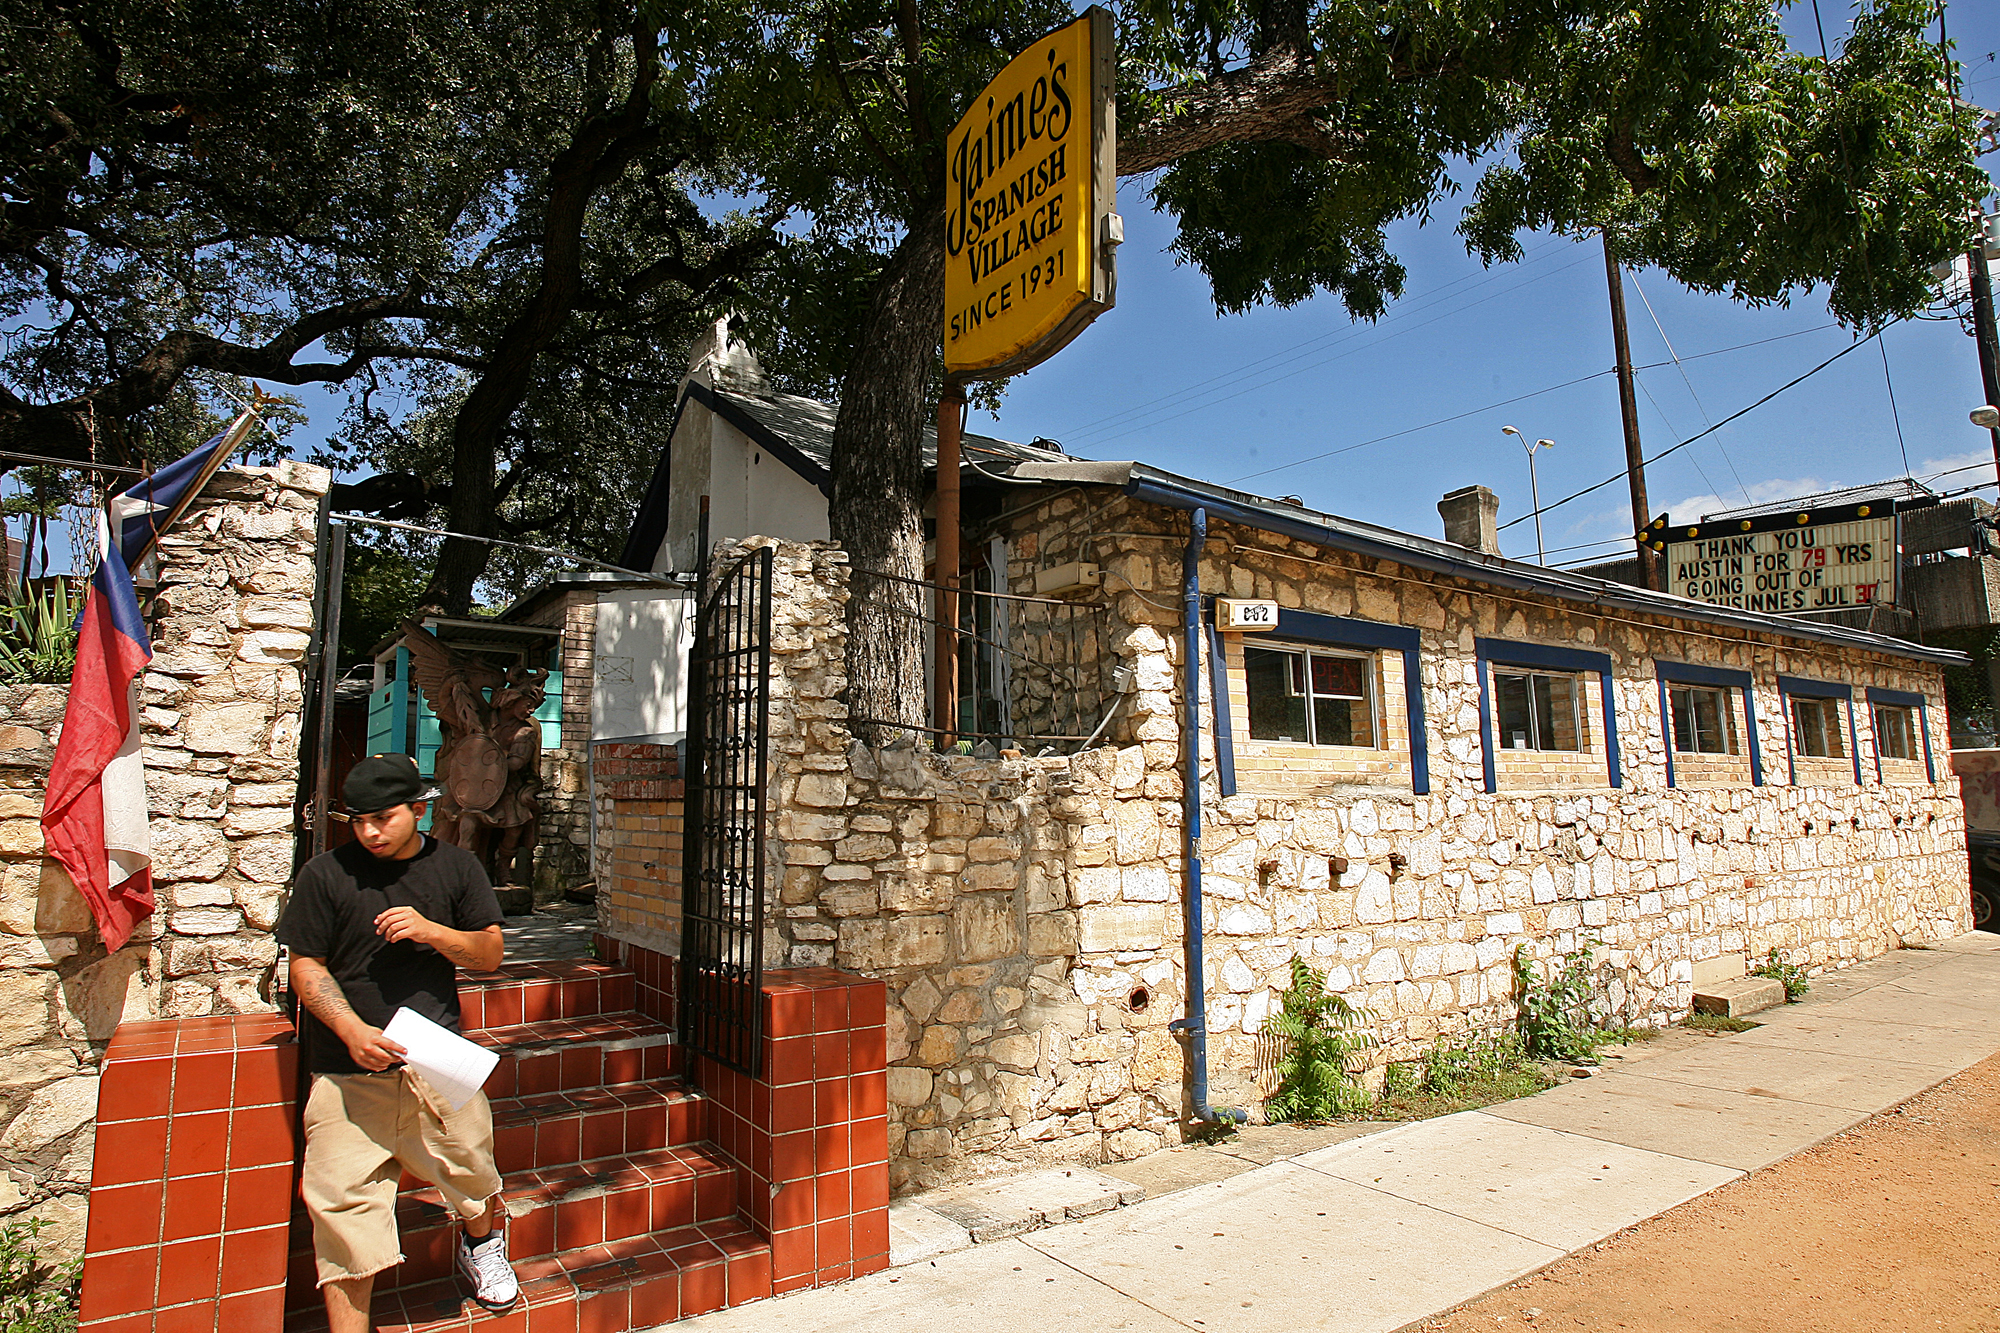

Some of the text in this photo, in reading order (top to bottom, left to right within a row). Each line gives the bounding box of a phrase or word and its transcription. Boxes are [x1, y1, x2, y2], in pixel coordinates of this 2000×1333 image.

[947, 48, 1072, 257] Jaime's
[966, 143, 1067, 246] SPANISH
[967, 193, 1063, 286] VILLAGE
[951, 248, 1065, 341] SINCE 1931
[1678, 543, 1872, 580] AUSTIN FOR 79 YRS
[1695, 529, 1815, 559] THANK YOU
[1687, 569, 1823, 598] GOING OUT OF
[1814, 587, 1849, 606] JUL
